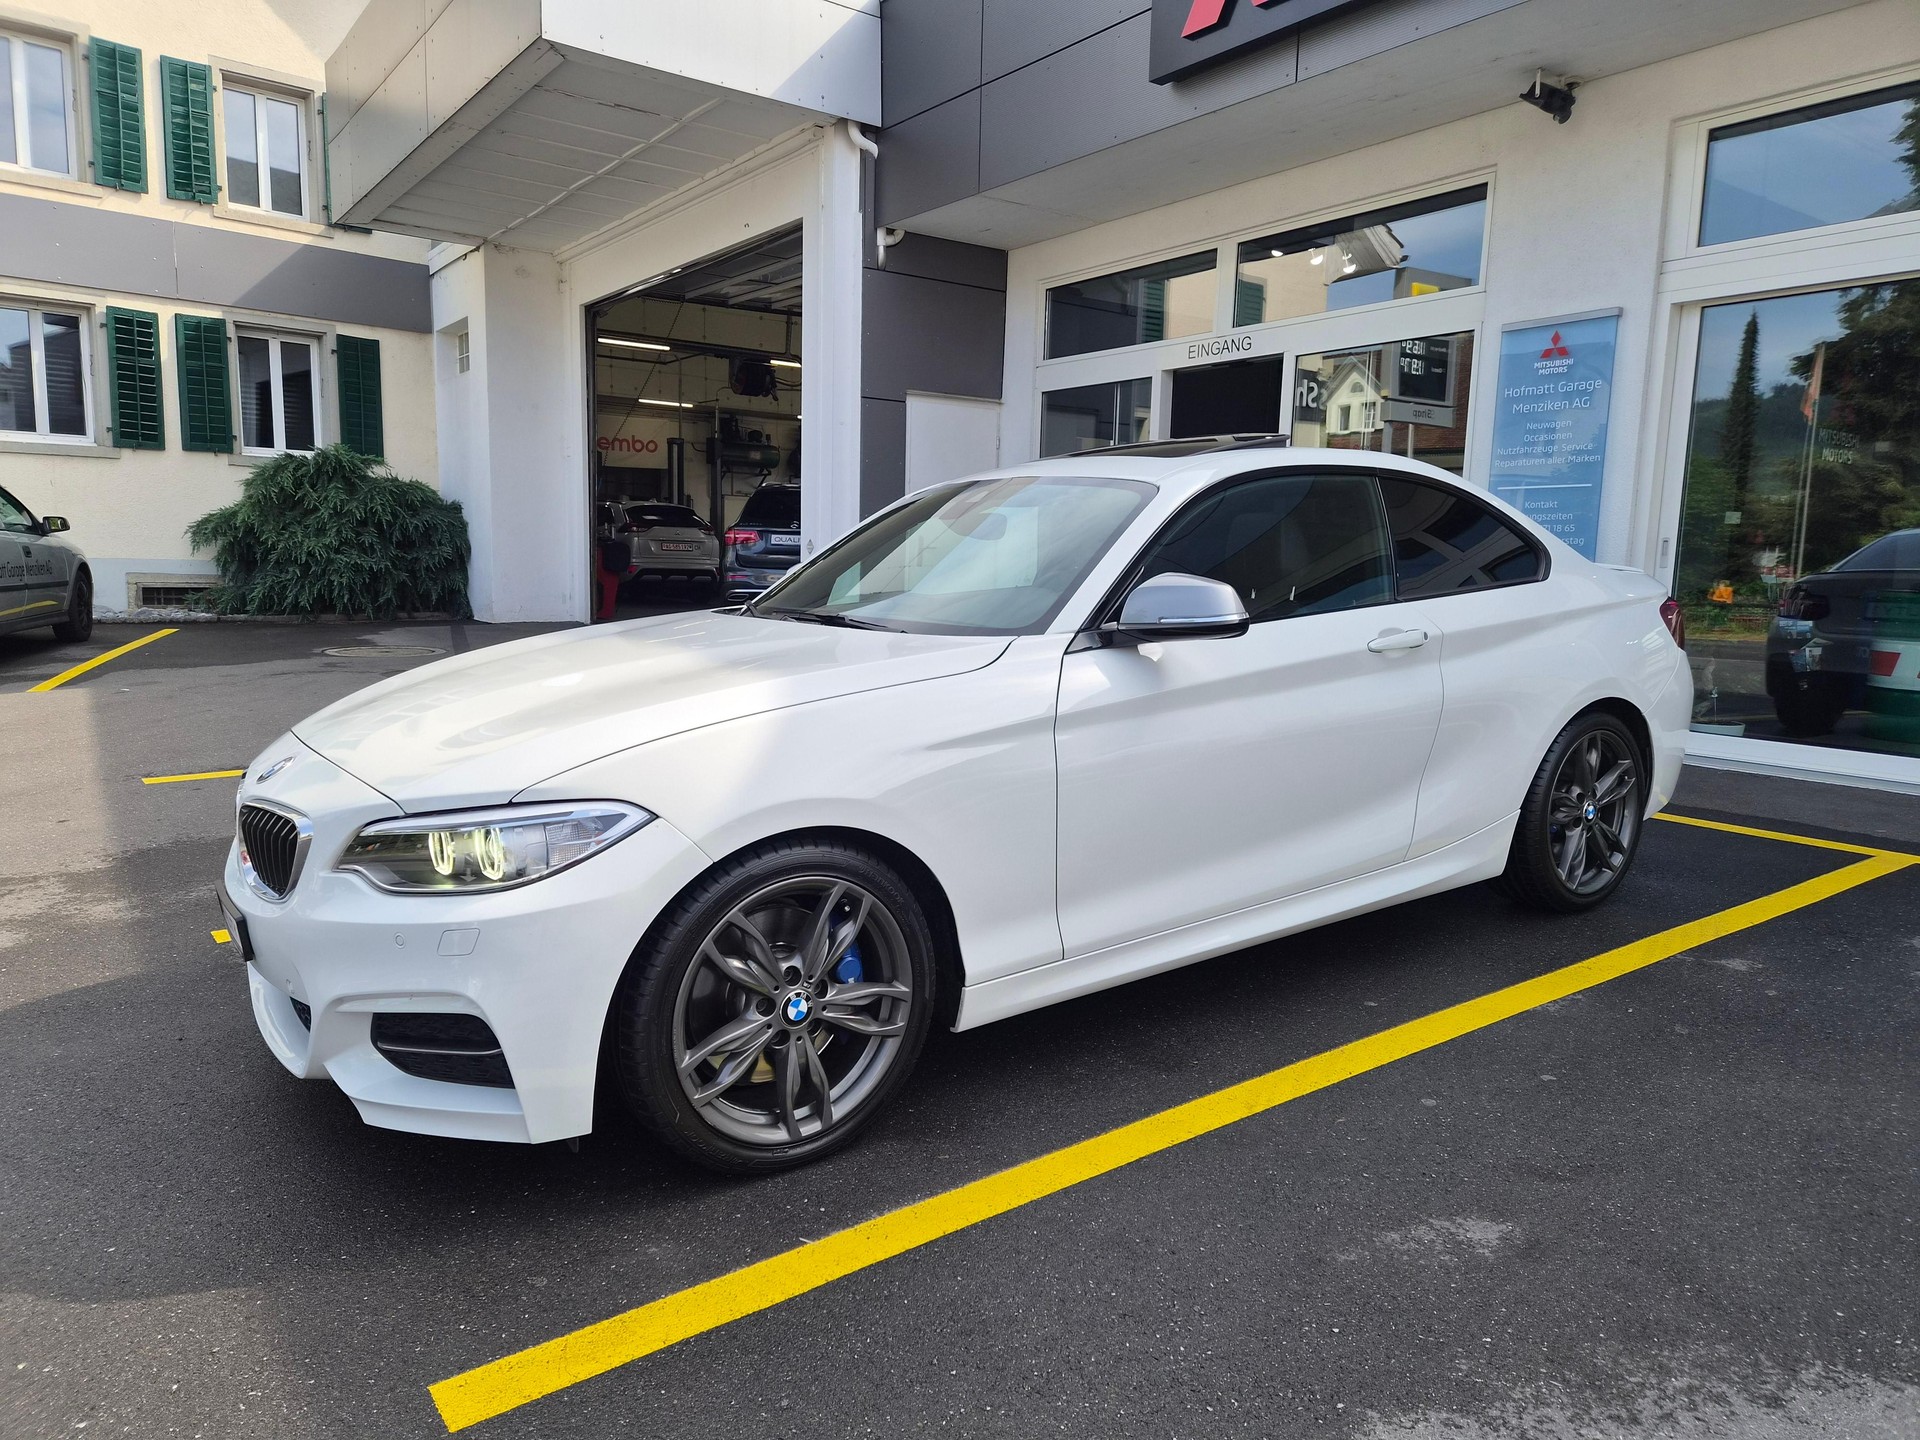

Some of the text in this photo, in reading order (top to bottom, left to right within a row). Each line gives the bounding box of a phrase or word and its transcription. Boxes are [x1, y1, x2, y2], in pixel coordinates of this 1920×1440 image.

[1188, 335, 1252, 360] EINGANG
[1533, 358, 1574, 369] MITSUBISHI
[1538, 366, 1568, 375] MOTORS
[1504, 379, 1602, 398] Hofmatt Garage
[1512, 396, 1591, 414] Menziken AG
[1526, 419, 1572, 430] Neuwagen
[1524, 431, 1573, 442] Occasionen
[1818, 427, 1861, 449] MITSUBISHI
[597, 434, 659, 453] embo
[1497, 443, 1558, 455] Nutzfahrzeuge
[1495, 454, 1601, 468] Reparaturen aller Marken
[1822, 447, 1854, 465] MOTORS
[1524, 500, 1559, 509] Kontakt
[1526, 512, 1573, 522] ungszeiten
[1553, 524, 1562, 532] 18
[1564, 524, 1576, 532] 65
[773, 536, 801, 544] QUALI
[1561, 537, 1585, 546] rstag
